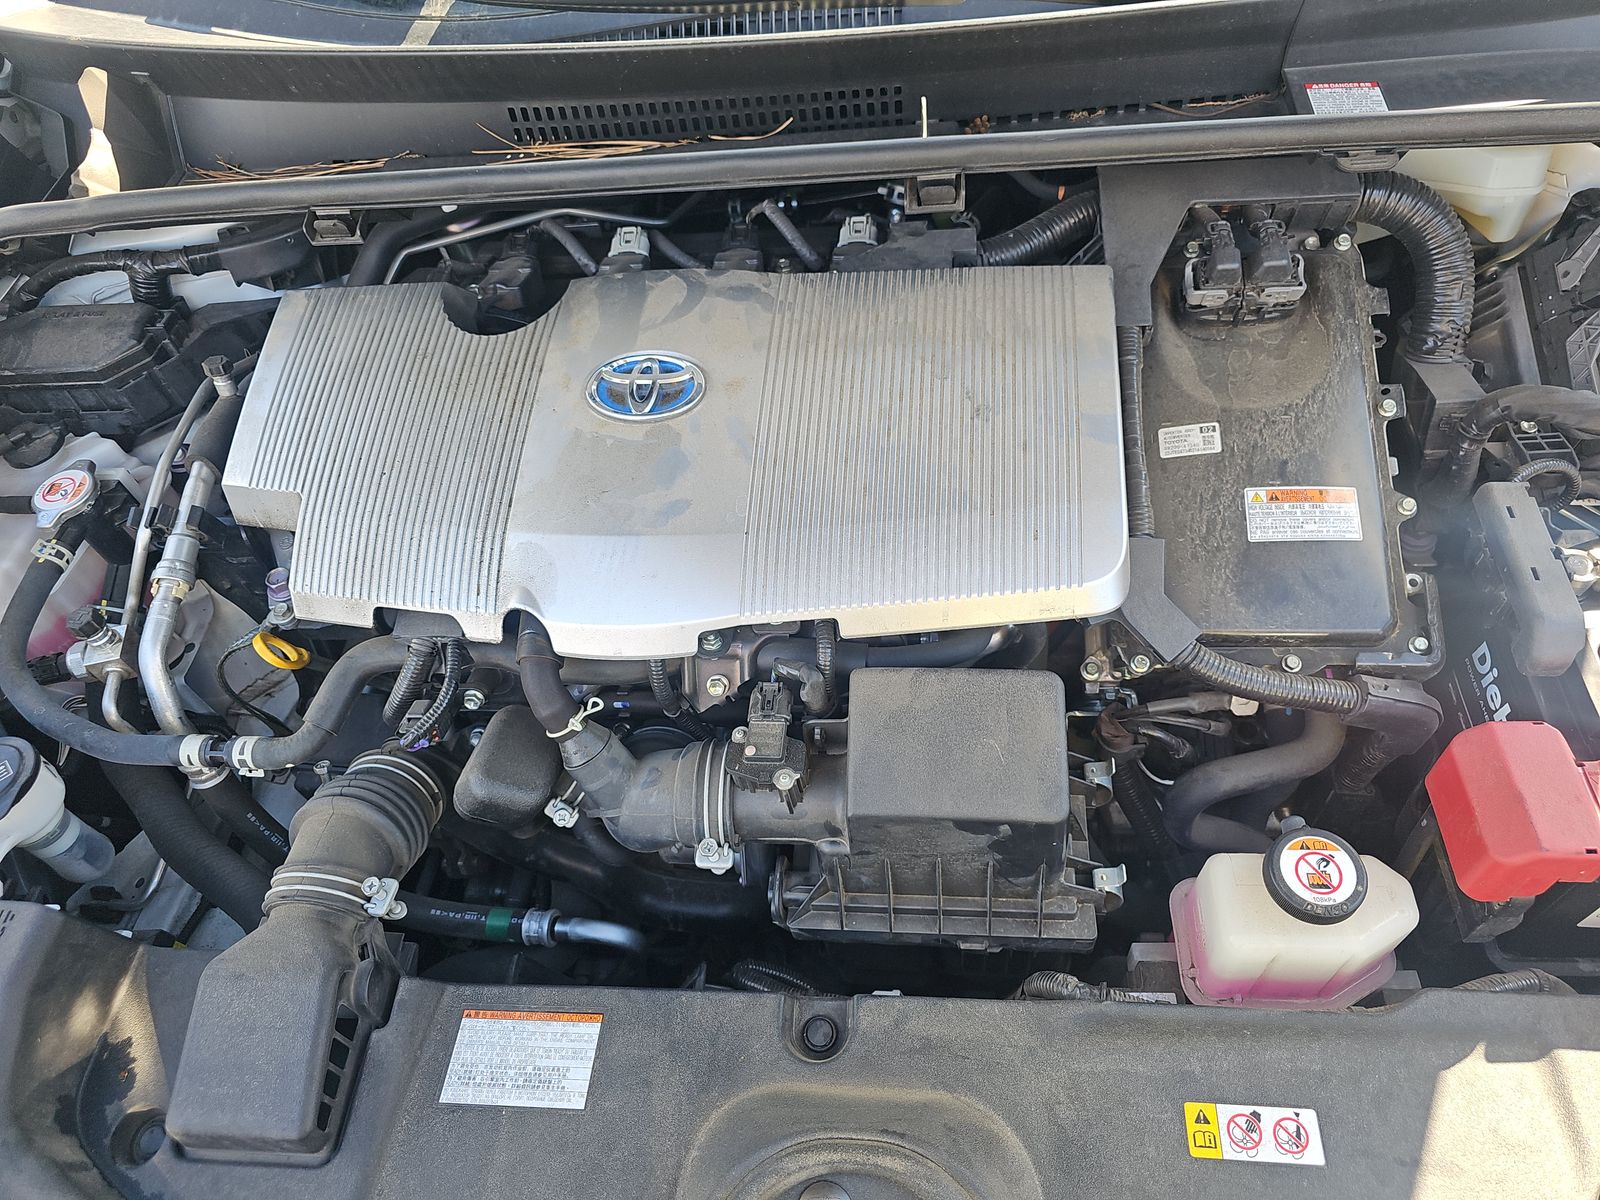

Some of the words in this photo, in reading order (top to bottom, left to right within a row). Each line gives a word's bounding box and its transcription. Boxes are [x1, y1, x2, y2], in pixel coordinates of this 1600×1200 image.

[1464, 658, 1481, 697] POWER
[1303, 902, 1350, 917] DENSO
[518, 1012, 563, 1020] AVERTISSEMENT
